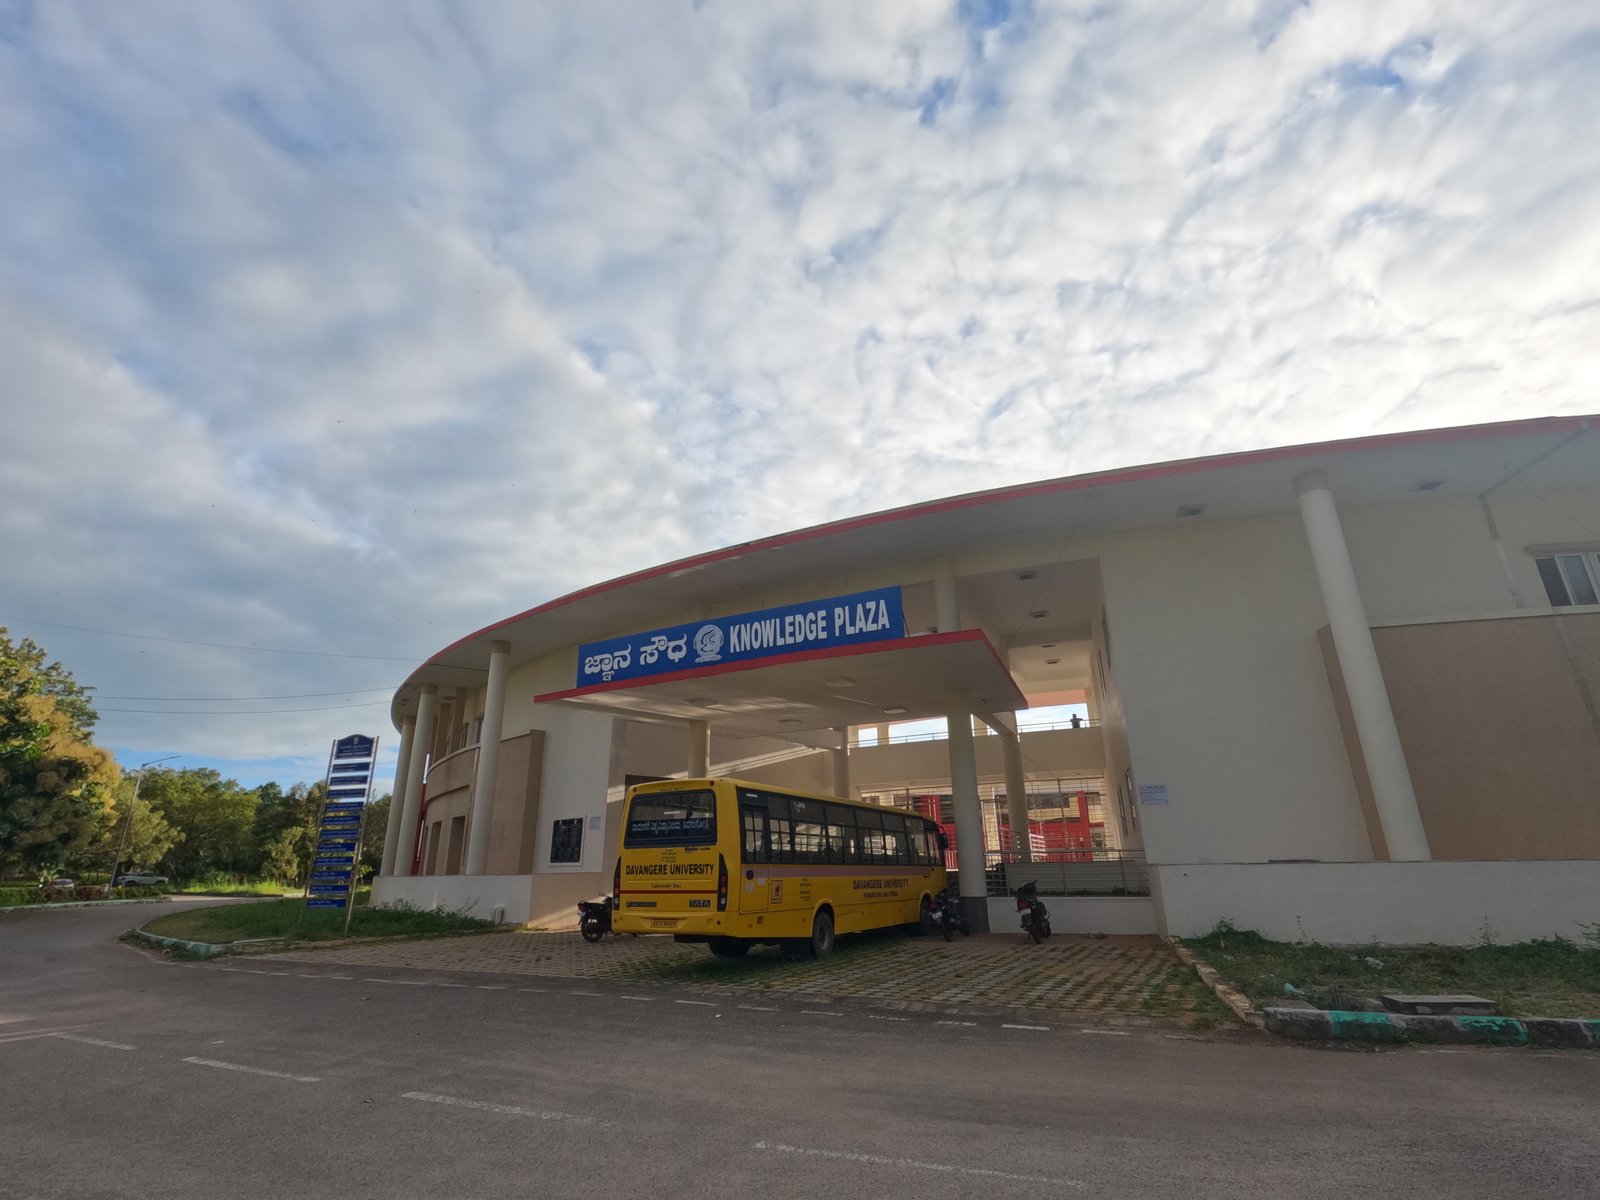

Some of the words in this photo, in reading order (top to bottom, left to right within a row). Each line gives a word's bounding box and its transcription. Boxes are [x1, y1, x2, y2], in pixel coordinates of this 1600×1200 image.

[729, 610, 828, 653] KNOWLEDGE
[834, 600, 890, 637] PLAZA
[584, 643, 632, 681] ಜ್ಞಾನ
[640, 633, 687, 665] ಸೌಧ
[626, 864, 668, 875] DAVANGERE
[670, 864, 715, 875] UNIVERSITY
[853, 879, 882, 890] DAVANGERE
[883, 878, 909, 889] UNIVERSITY
[690, 899, 709, 908] TATA
